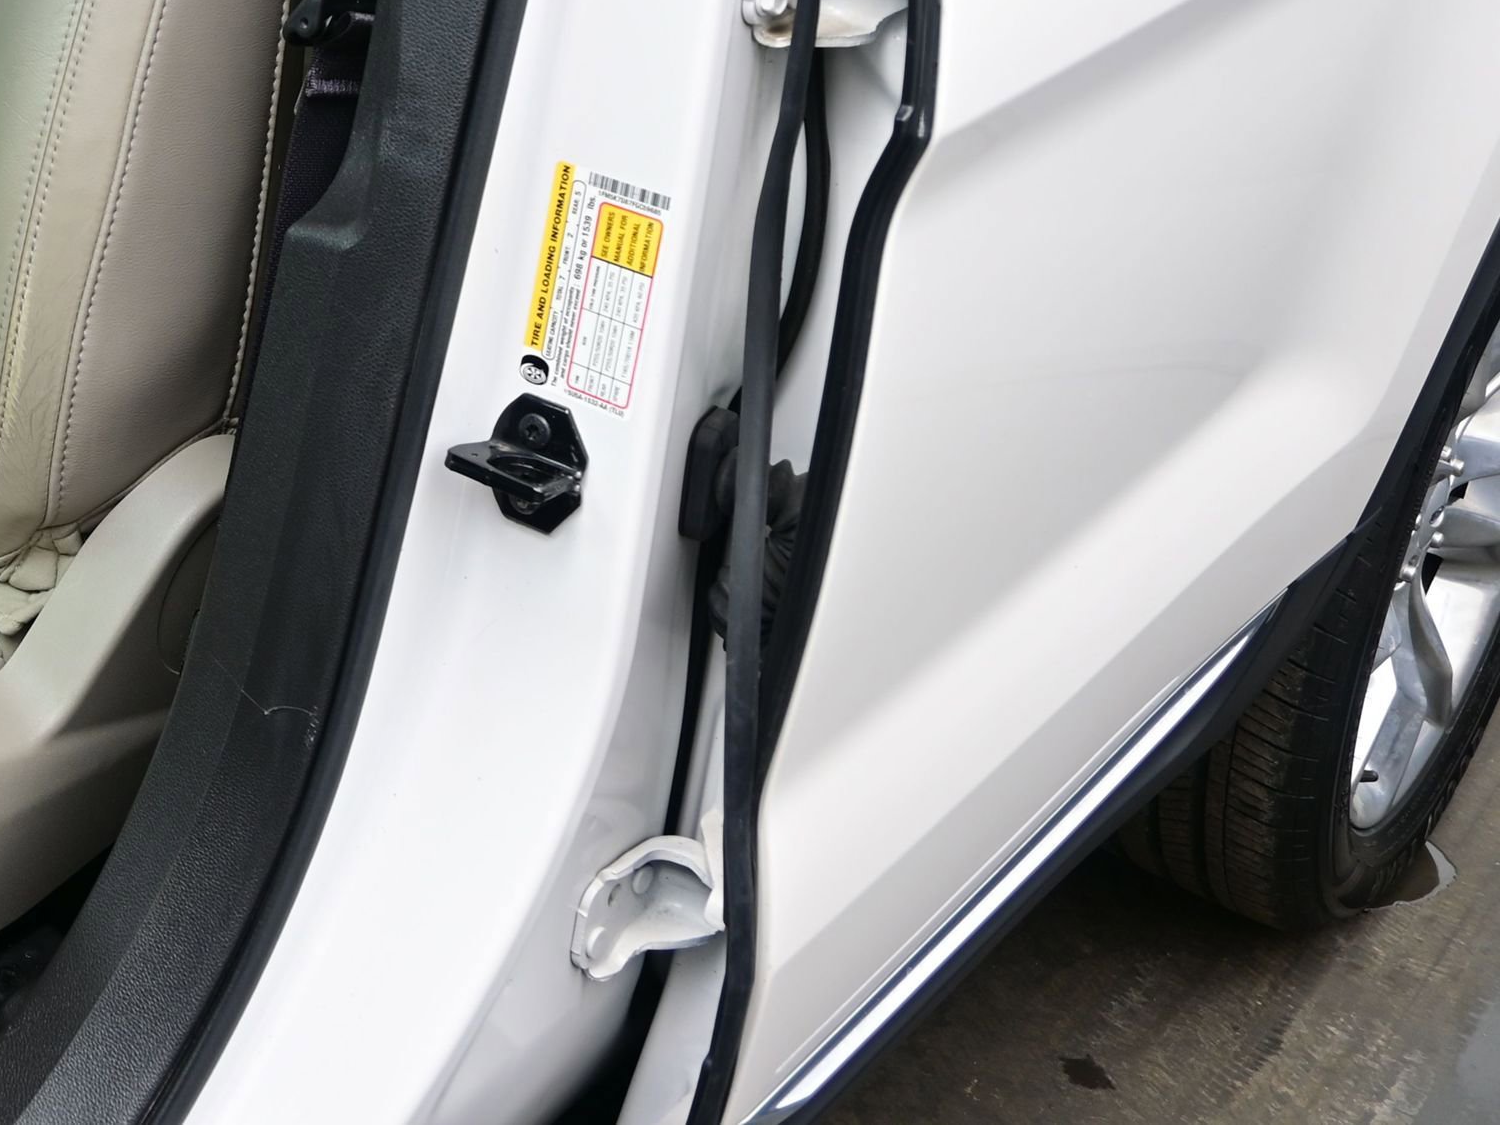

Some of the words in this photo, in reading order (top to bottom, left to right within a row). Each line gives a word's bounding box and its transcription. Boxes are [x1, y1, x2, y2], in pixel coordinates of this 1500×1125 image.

[551, 166, 571, 241] INFORMATION
[582, 216, 593, 236] 1539
[604, 212, 616, 242] OWNERS
[614, 233, 625, 262] MANUAL
[620, 215, 628, 229] FOR
[578, 250, 587, 260] kg
[601, 246, 609, 257] SEE
[626, 223, 641, 265] ADDITIONAL
[639, 222, 655, 271] INFORMATION
[541, 246, 556, 293] LOADING
[574, 263, 584, 279] 698
[537, 296, 547, 318] AND
[531, 322, 542, 347] TIRE
[559, 325, 569, 346] weight
